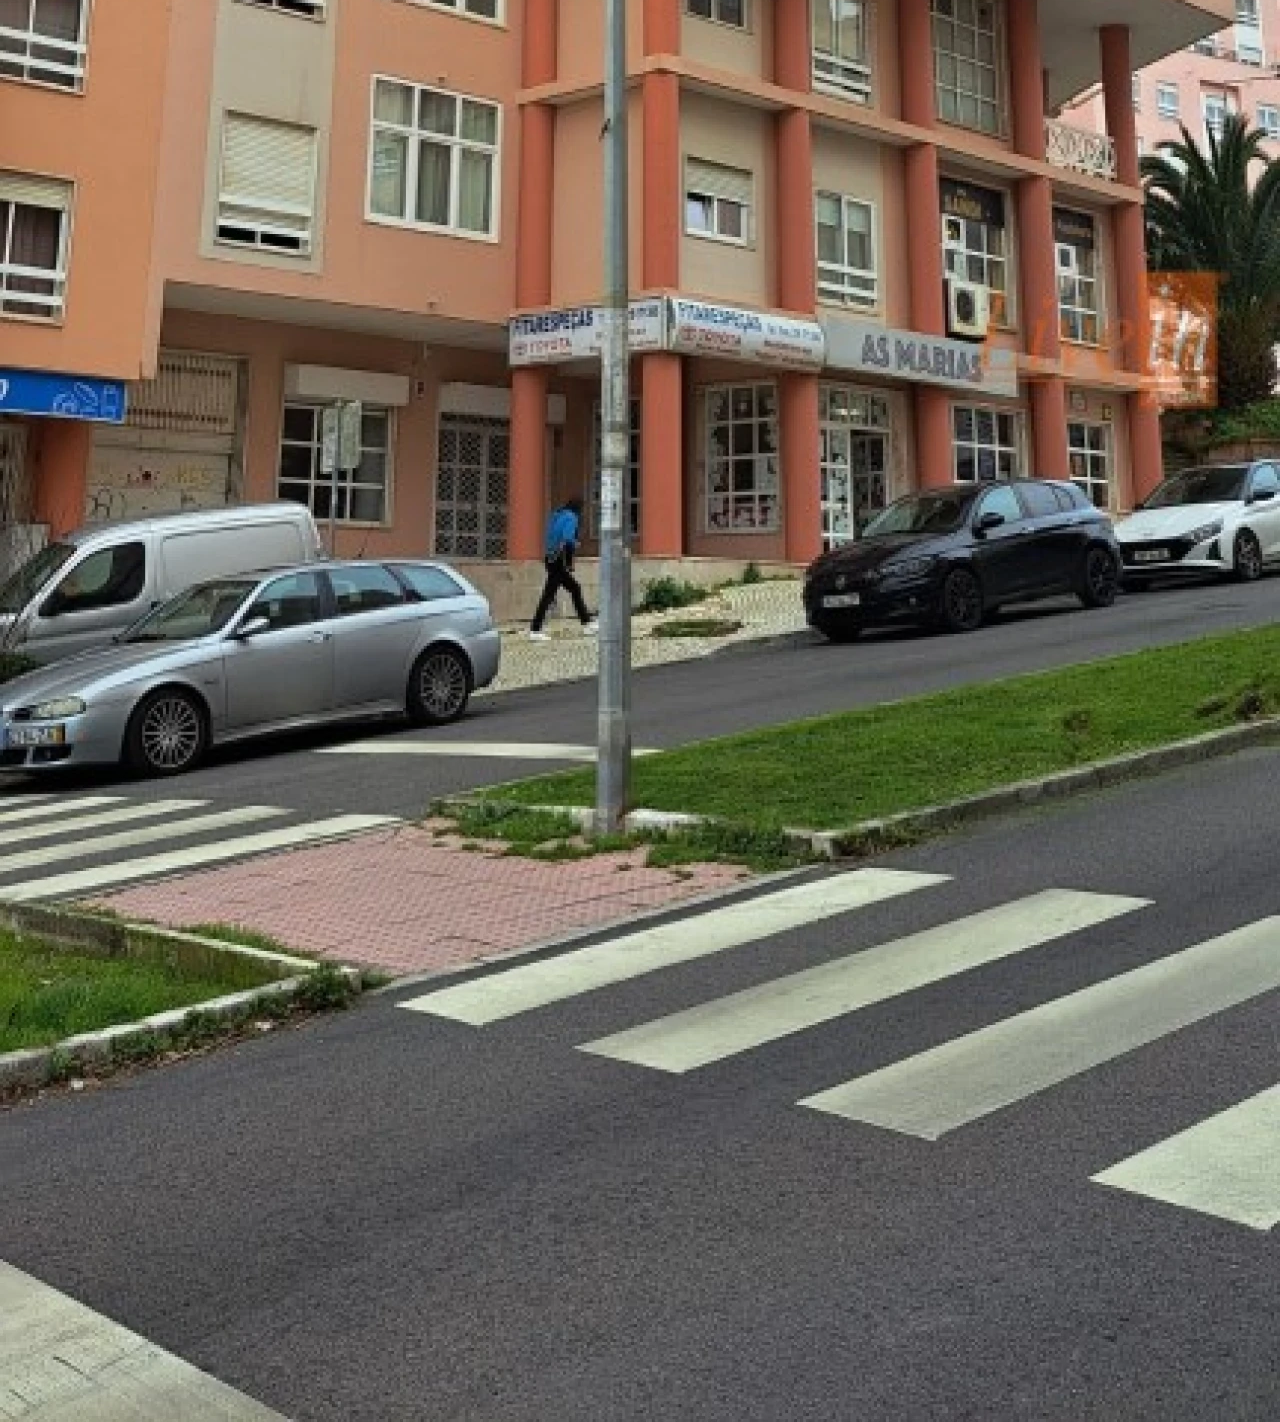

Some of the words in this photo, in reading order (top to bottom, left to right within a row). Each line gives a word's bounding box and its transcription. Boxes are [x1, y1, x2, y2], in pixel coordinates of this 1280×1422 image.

[524, 337, 573, 353] TOYOTA
[698, 328, 742, 345] TOYOTA
[861, 334, 889, 368] AS
[895, 339, 982, 383] MARIAS
